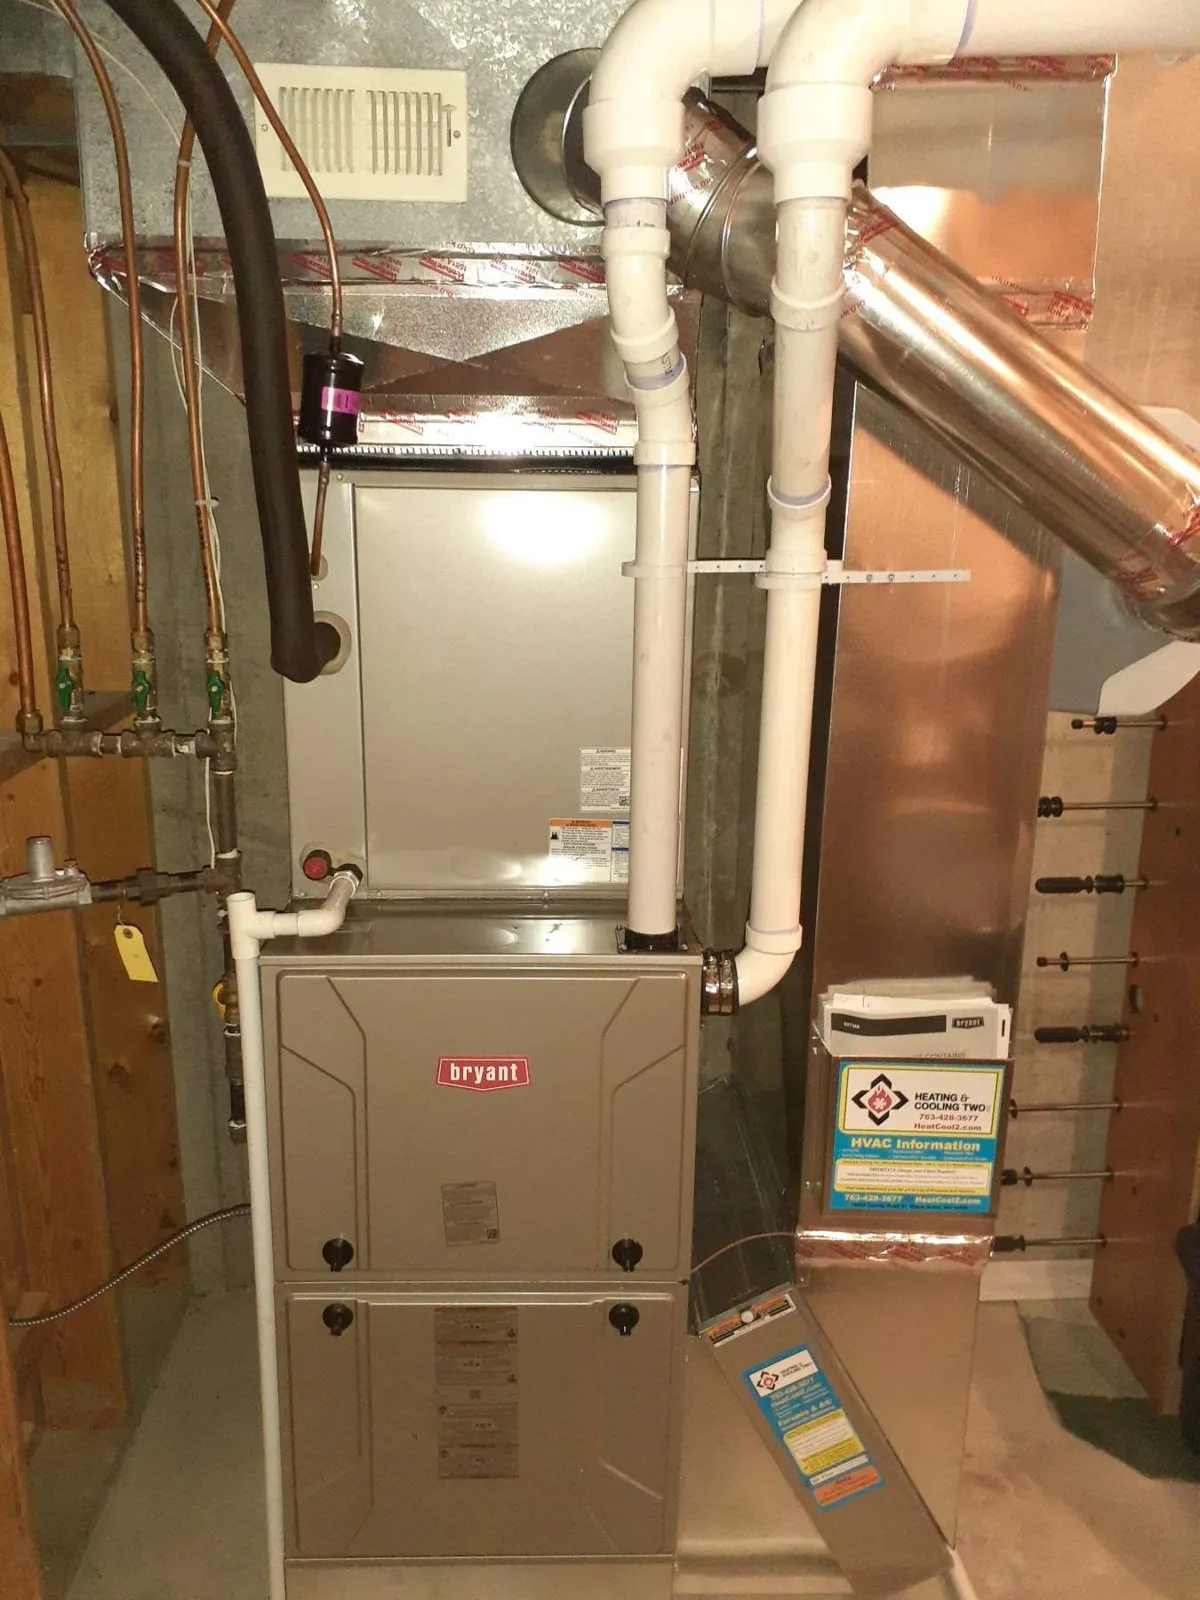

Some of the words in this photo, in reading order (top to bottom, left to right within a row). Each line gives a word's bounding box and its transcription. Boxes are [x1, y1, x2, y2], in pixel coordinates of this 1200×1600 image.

[450, 1063, 518, 1084] bryant
[914, 1092, 958, 1102] HEATING
[914, 1102, 960, 1112] COOLING
[963, 1103, 986, 1113] TWO
[919, 1113, 979, 1122] 763-428-3677
[913, 1123, 982, 1132] HeatCool2.com
[850, 1138, 892, 1149] HVAC
[896, 1138, 981, 1151] Information
